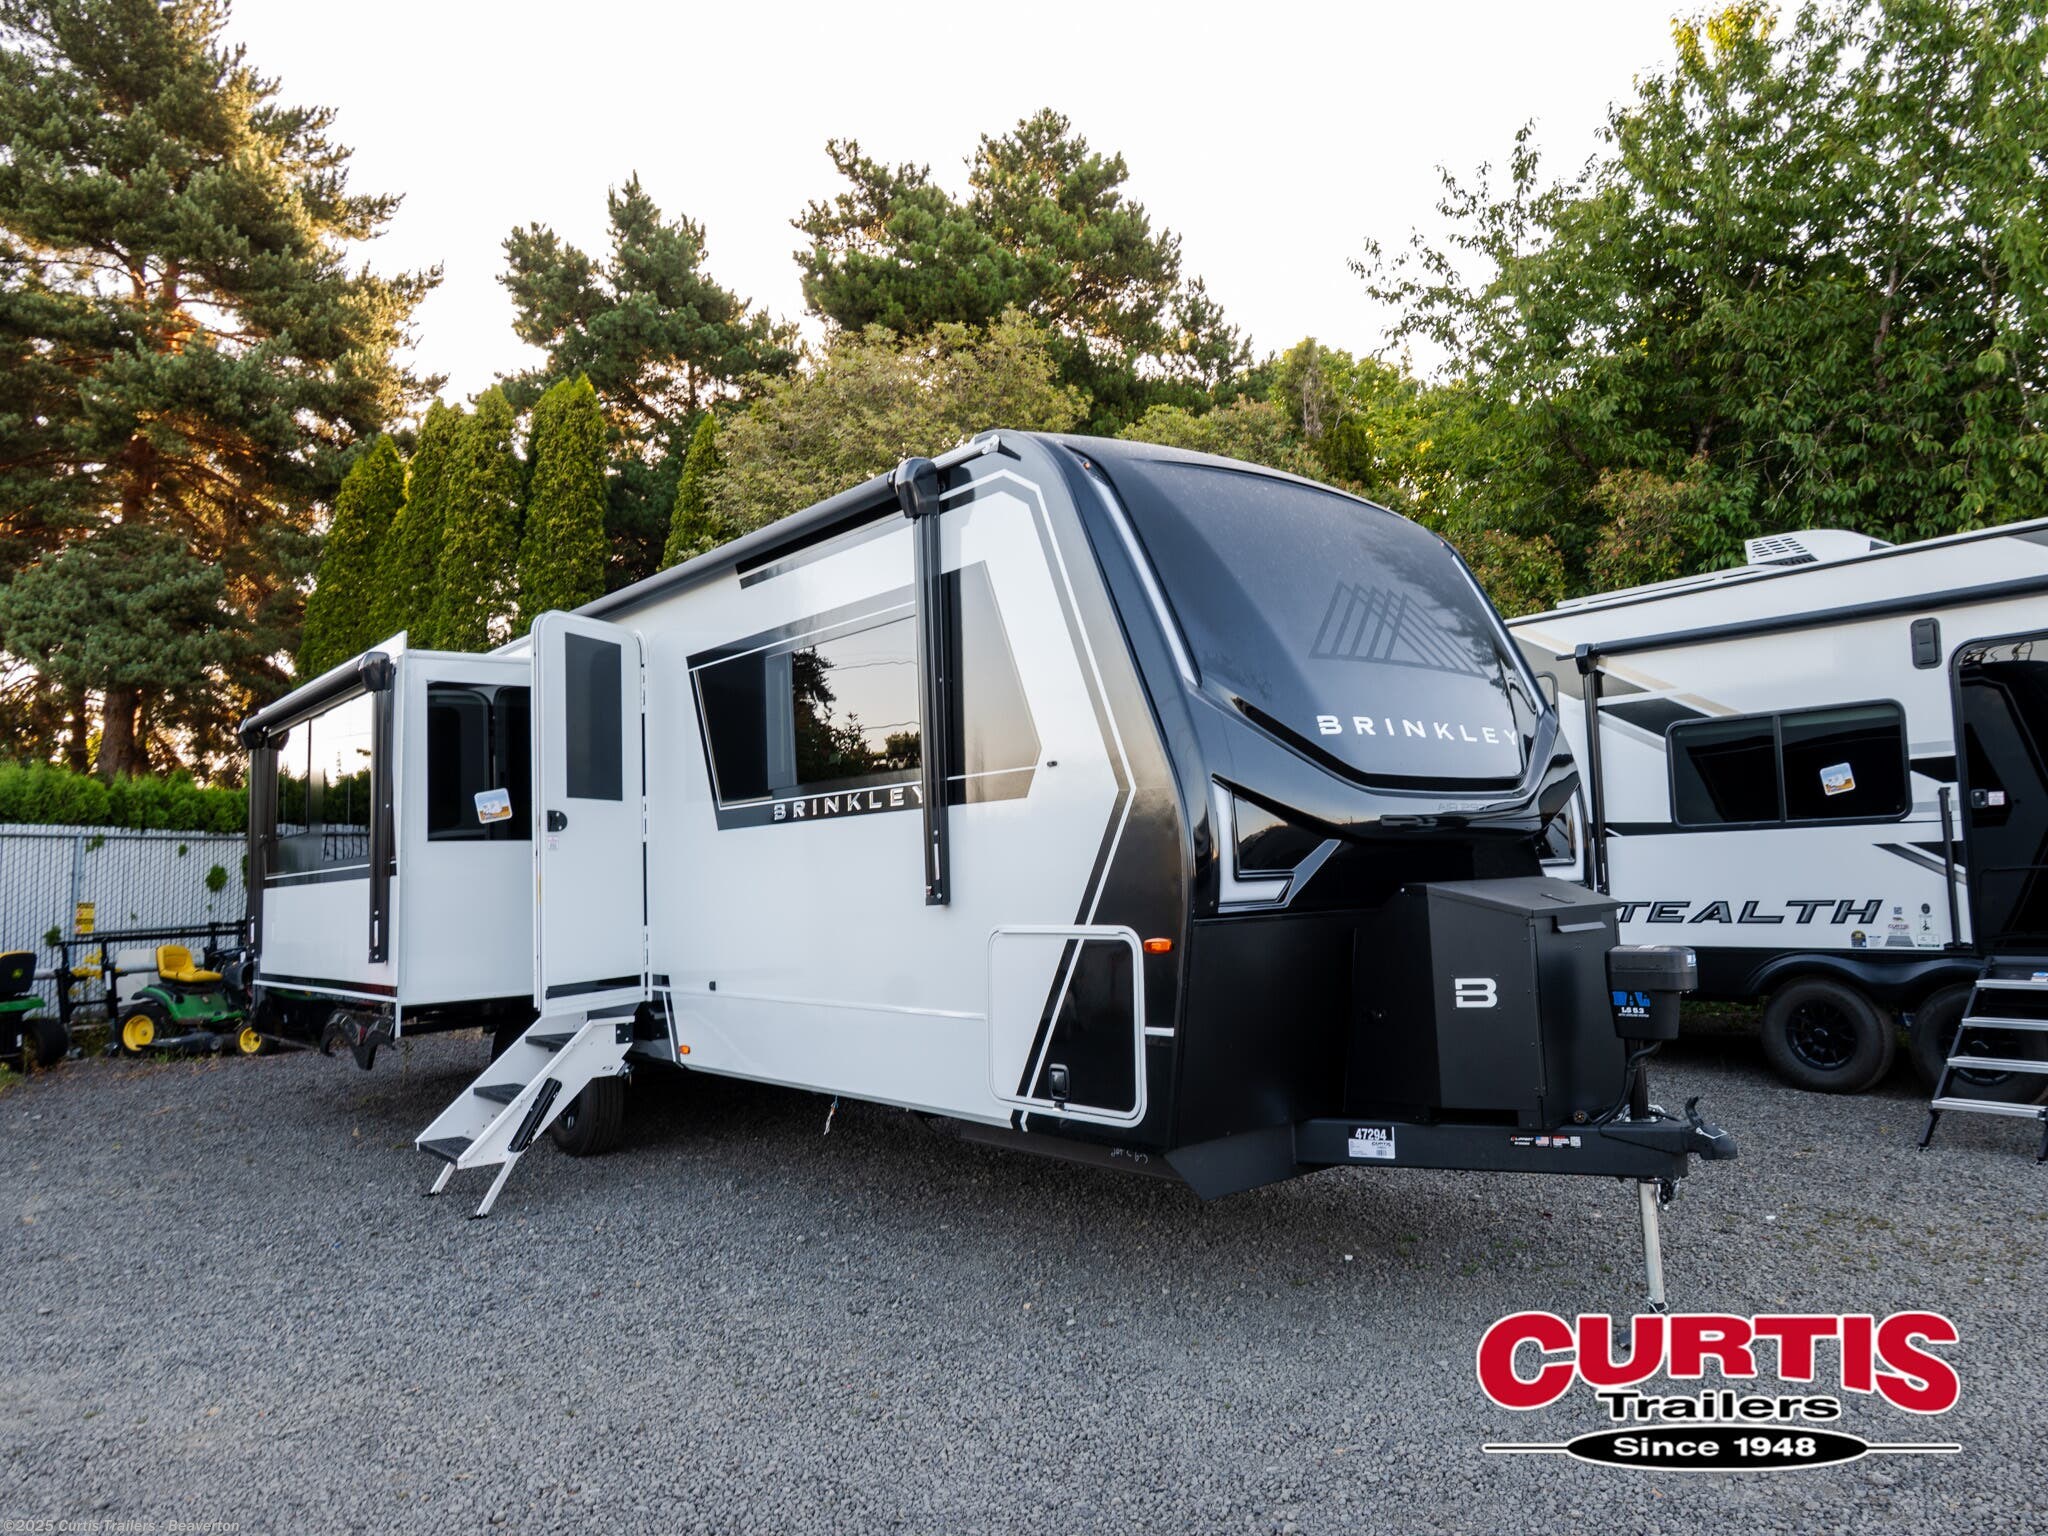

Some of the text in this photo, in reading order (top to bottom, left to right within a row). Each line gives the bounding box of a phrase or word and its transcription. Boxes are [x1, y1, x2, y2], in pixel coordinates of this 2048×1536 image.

[1316, 714, 1519, 746] BRINKLEY
[1619, 899, 1885, 924] TEALTH
[1455, 978, 1498, 1008] B
[1355, 1128, 1387, 1141] 47294
